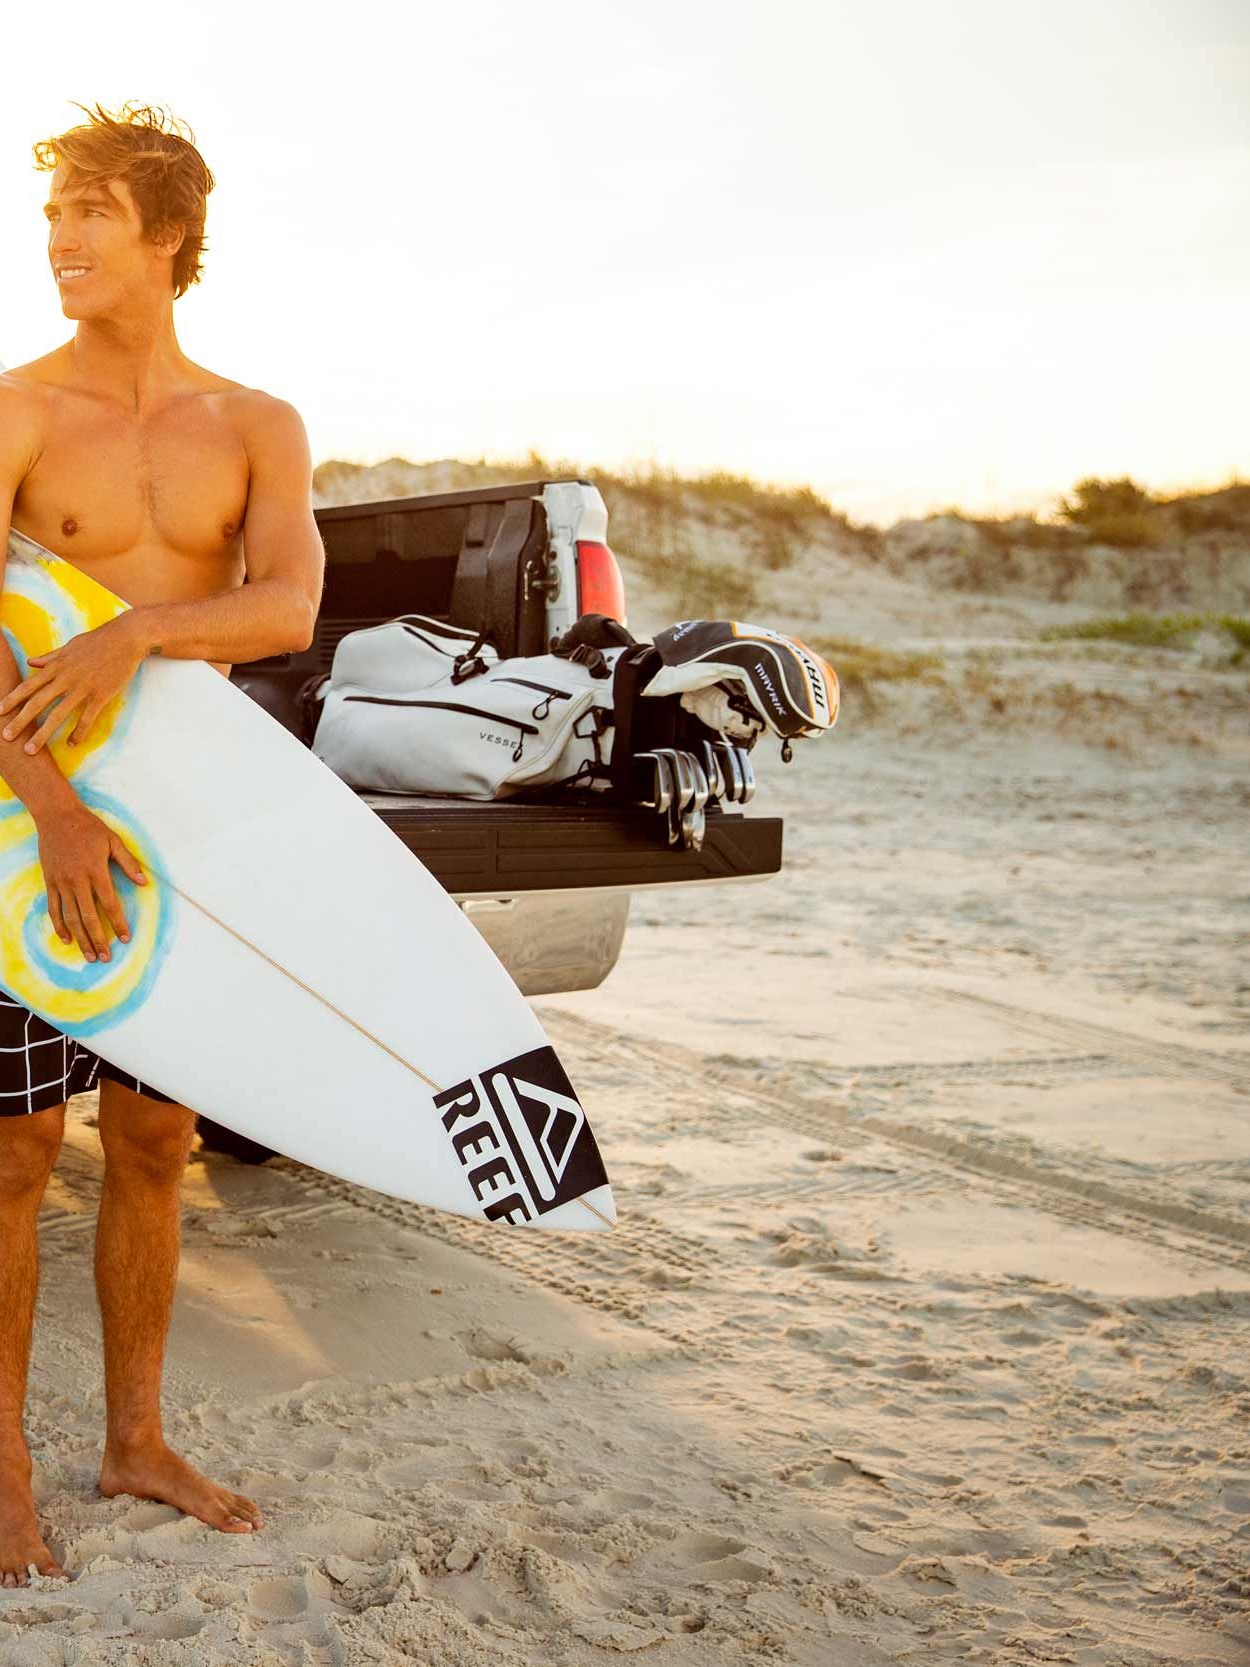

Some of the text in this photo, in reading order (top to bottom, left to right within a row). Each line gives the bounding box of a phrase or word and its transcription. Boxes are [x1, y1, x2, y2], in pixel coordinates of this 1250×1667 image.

[755, 663, 787, 716] MAVRIK
[479, 732, 520, 750] VESSE
[432, 1078, 532, 1226] REEF
